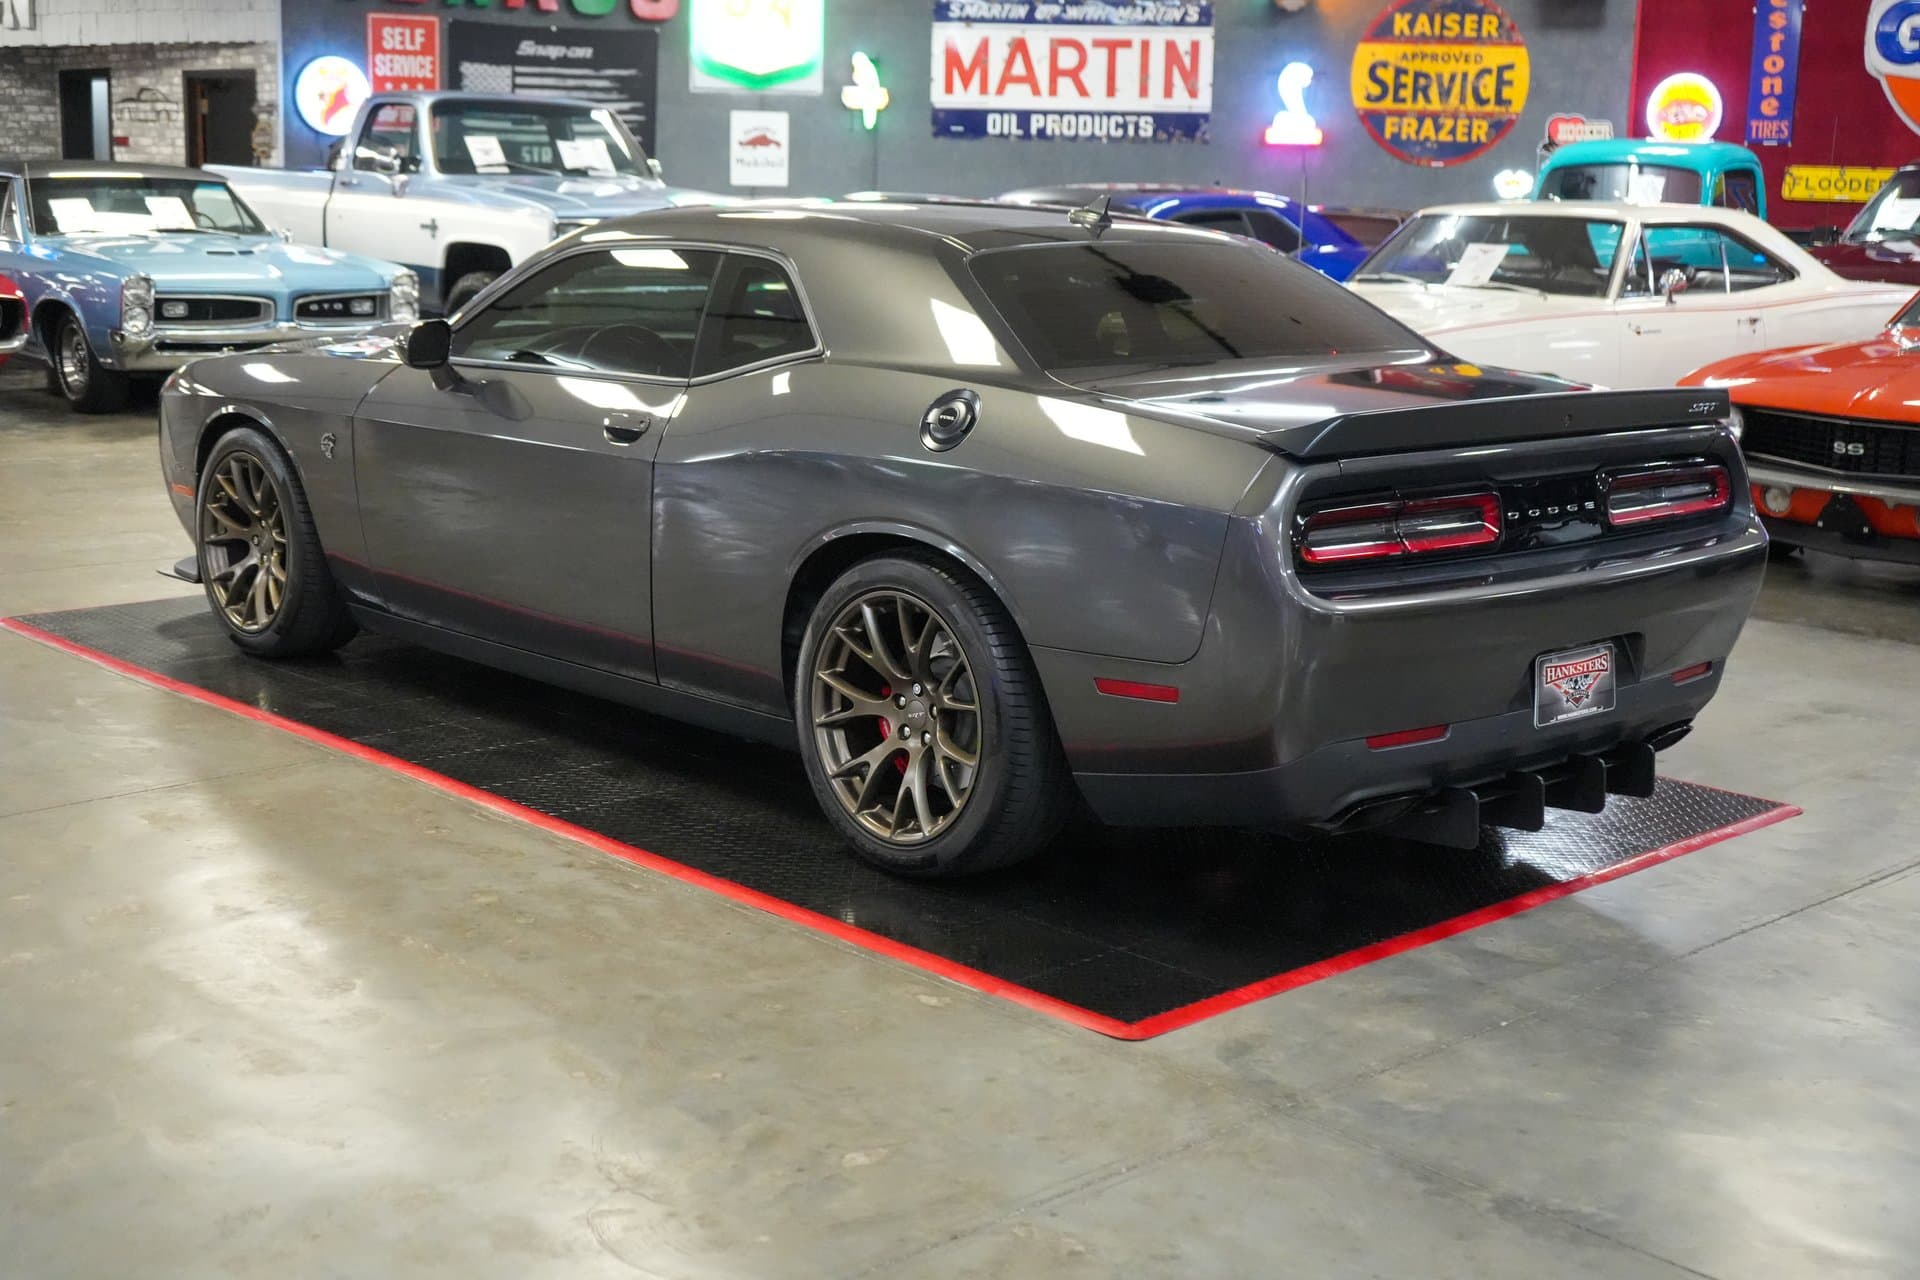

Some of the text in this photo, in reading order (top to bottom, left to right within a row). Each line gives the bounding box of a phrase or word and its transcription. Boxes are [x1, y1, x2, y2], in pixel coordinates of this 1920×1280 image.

[1393, 12, 1500, 39] KAISER
[381, 26, 426, 51] SELF
[516, 40, 594, 60] Snap-on
[375, 55, 433, 79] SERVICE
[944, 36, 1200, 99] MARTIN
[1401, 51, 1483, 64] APPROVED
[1365, 60, 1515, 107] SERVICE
[986, 113, 1154, 139] OIL PRODUCTS
[1384, 116, 1489, 143] FRAZER
[1751, 120, 1789, 139] TIRES
[1833, 440, 1864, 455] SS
[1507, 501, 1595, 520] DODGE
[1546, 655, 1607, 683] HANKSTERS
